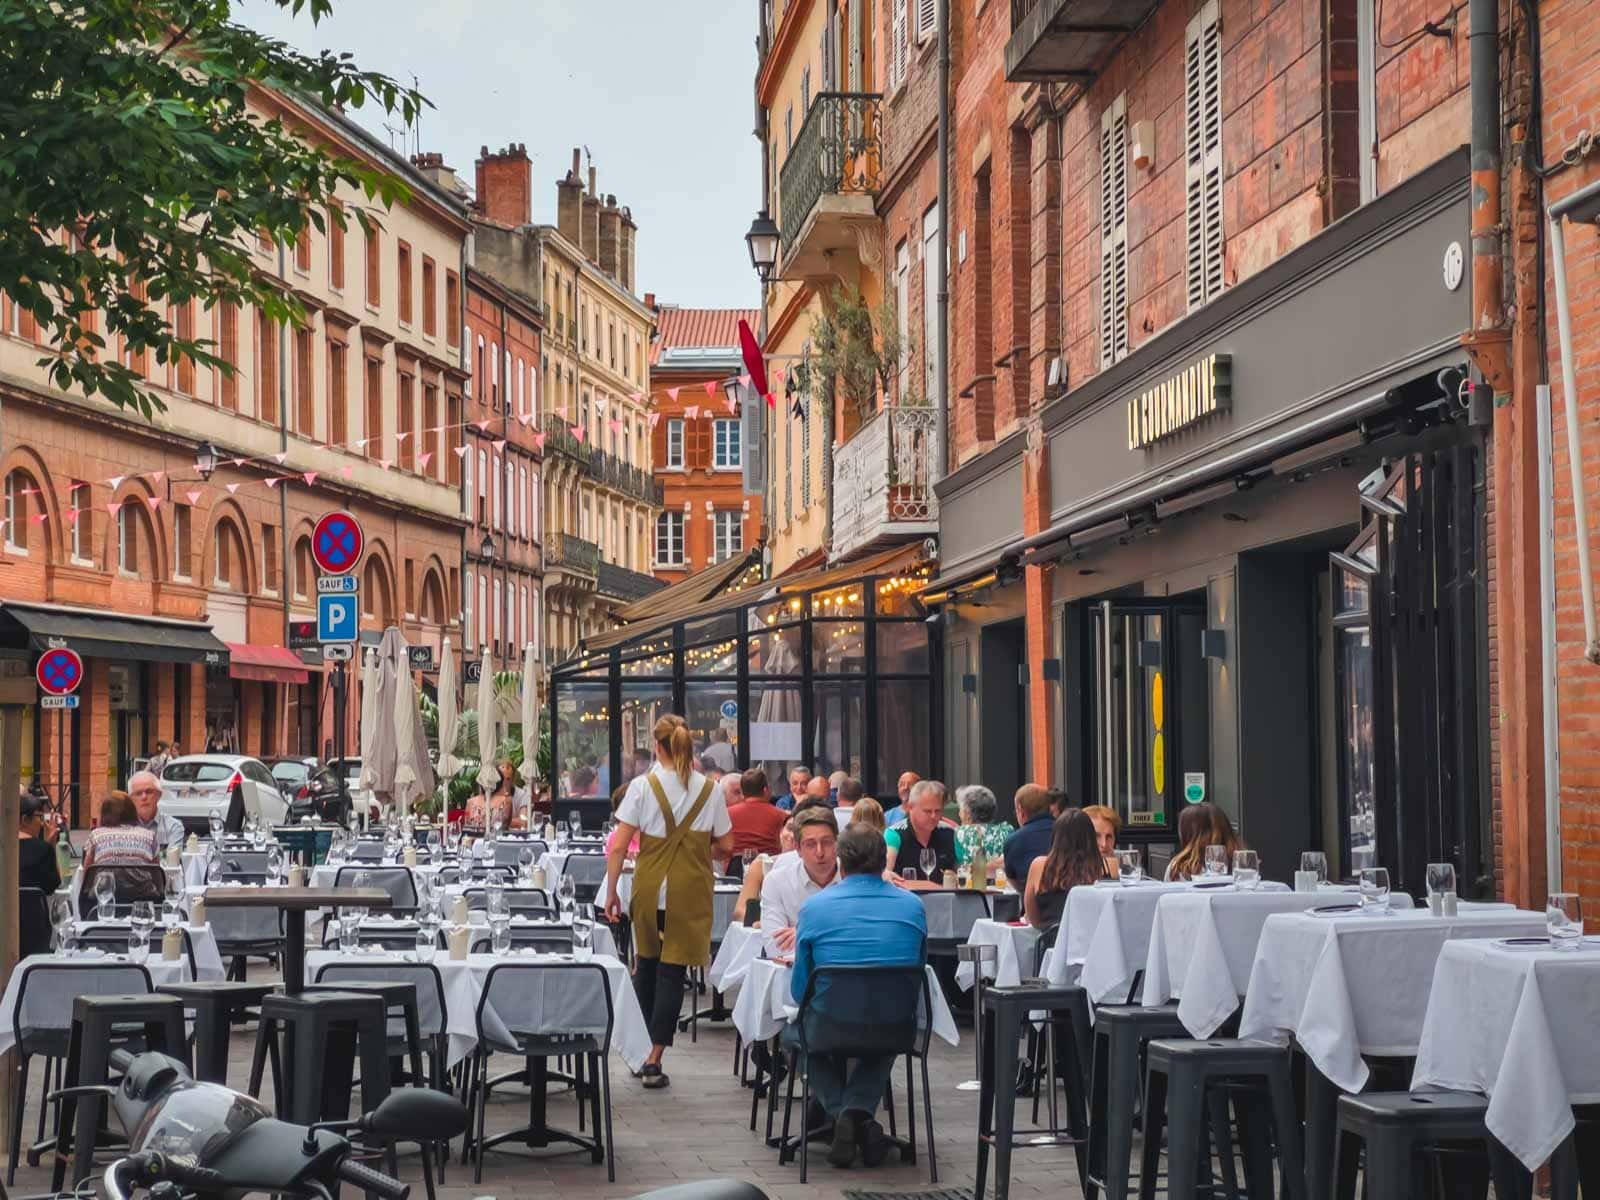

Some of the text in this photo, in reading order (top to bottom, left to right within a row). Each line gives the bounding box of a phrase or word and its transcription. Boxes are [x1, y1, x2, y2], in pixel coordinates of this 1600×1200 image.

[1127, 353, 1217, 451] LA GOURMANDINE
[319, 577, 342, 589] SAUF
[328, 603, 346, 633] P
[43, 698, 64, 706] SAUF
